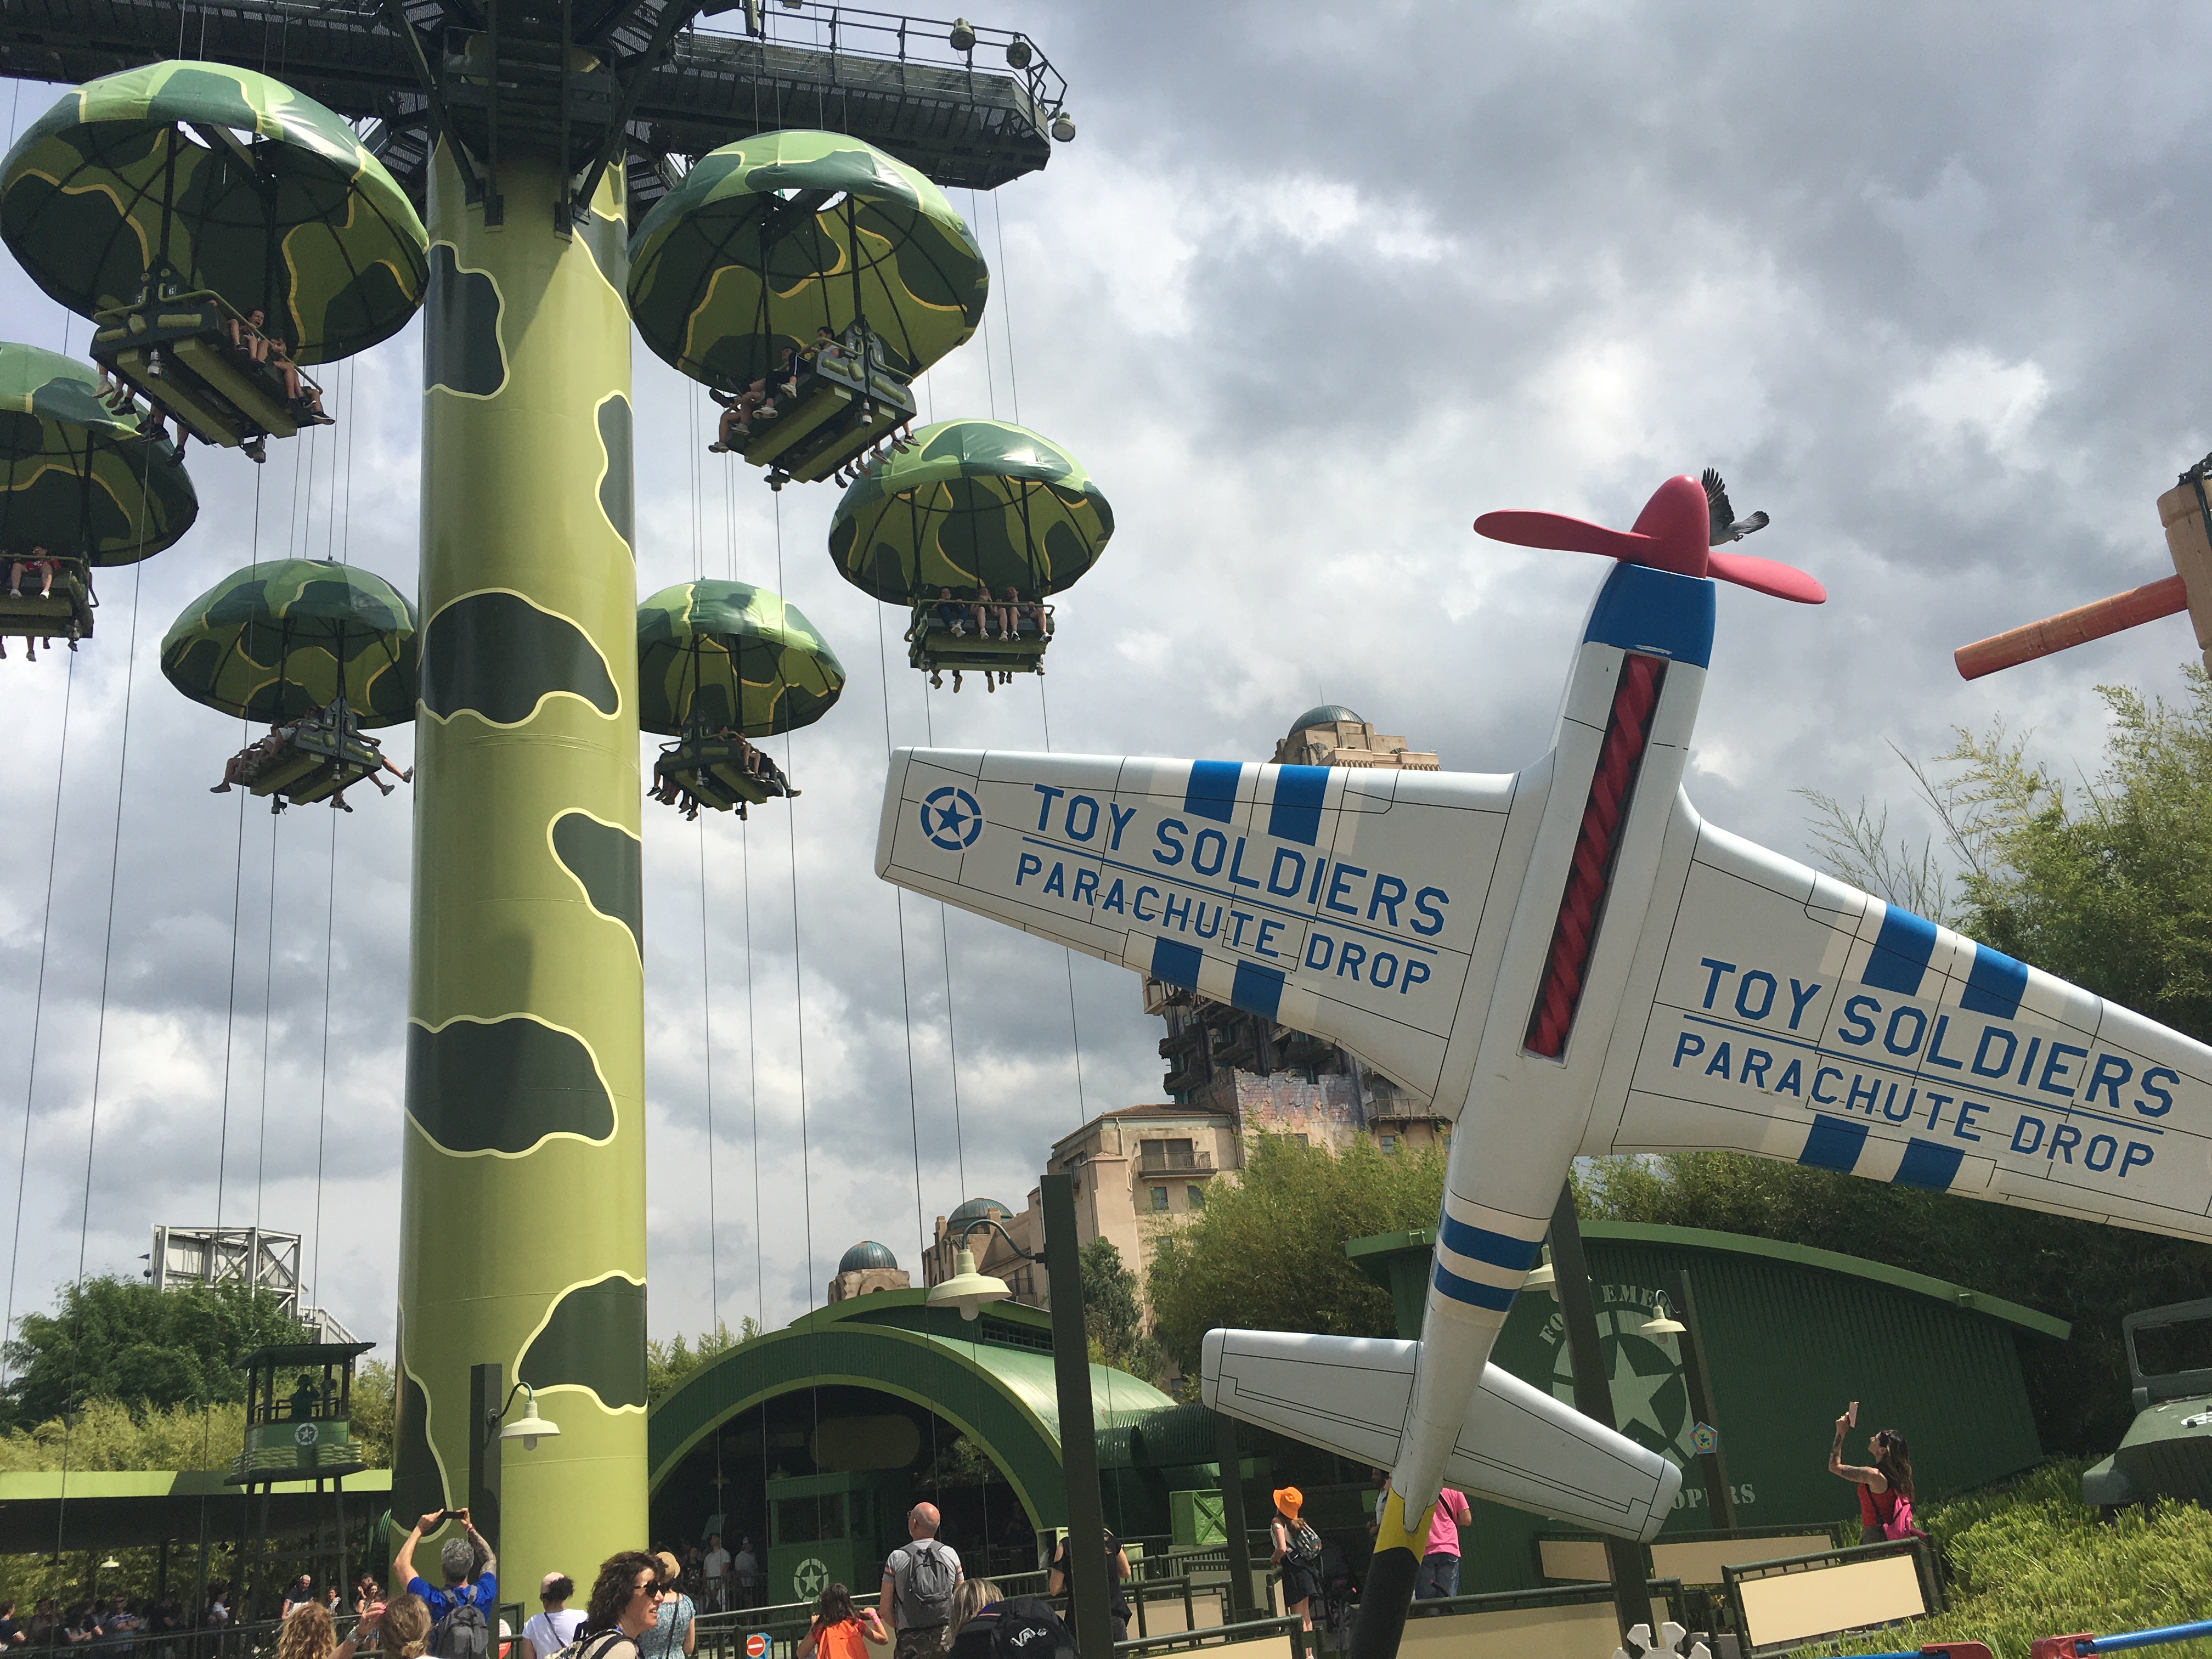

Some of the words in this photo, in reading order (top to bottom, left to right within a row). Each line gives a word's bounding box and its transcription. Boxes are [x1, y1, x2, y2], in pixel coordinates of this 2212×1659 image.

[1016, 853, 1285, 957] PARACHUTE
[1305, 933, 1431, 994] DROP
[1034, 784, 1136, 850] TOY
[1153, 818, 1449, 936] SOLDIERS
[1673, 1032, 1989, 1141] PARACHUTE
[2011, 1115, 2153, 1177] DROP
[1701, 958, 1821, 1029] TOY
[1838, 995, 2180, 1117] SOLDIERS
